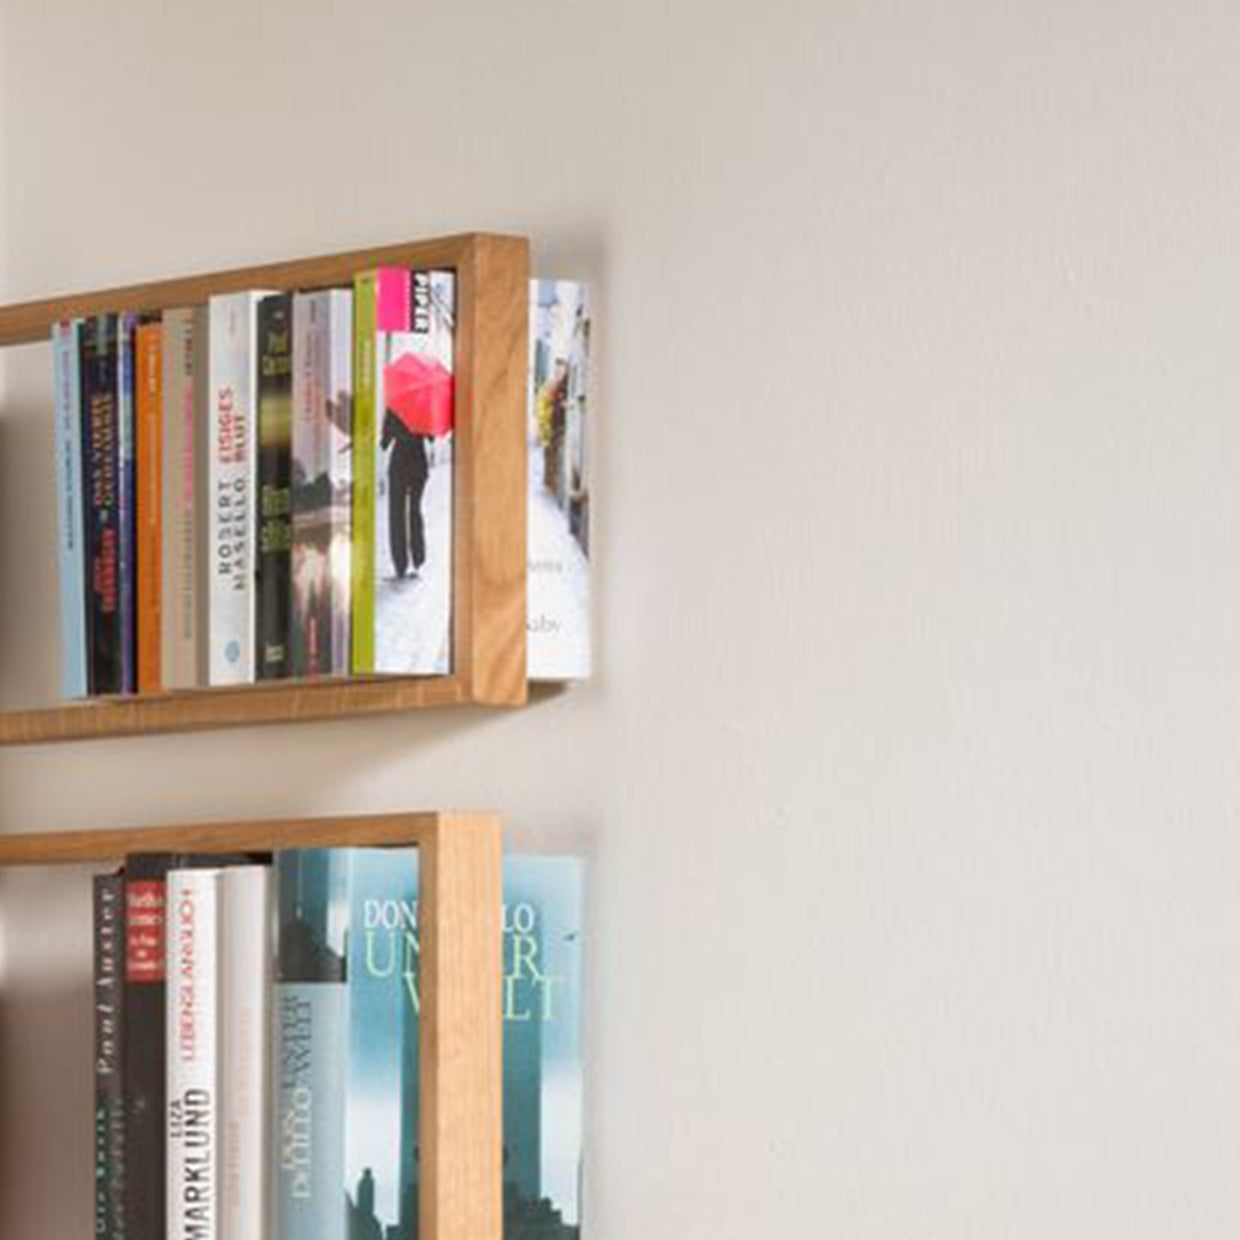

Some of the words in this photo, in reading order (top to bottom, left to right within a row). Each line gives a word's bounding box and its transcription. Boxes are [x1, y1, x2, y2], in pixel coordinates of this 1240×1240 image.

[414, 273, 428, 328] PIPER
[218, 388, 232, 464] EISIGES
[233, 413, 246, 464] BLUT
[218, 480, 232, 574] ROBERT
[233, 477, 246, 590] MASELLO
[97, 886, 115, 988] Auster
[363, 899, 419, 929] DON
[365, 930, 544, 980] UNR
[97, 1004, 114, 1074] Paul
[169, 1099, 184, 1138] LIZA
